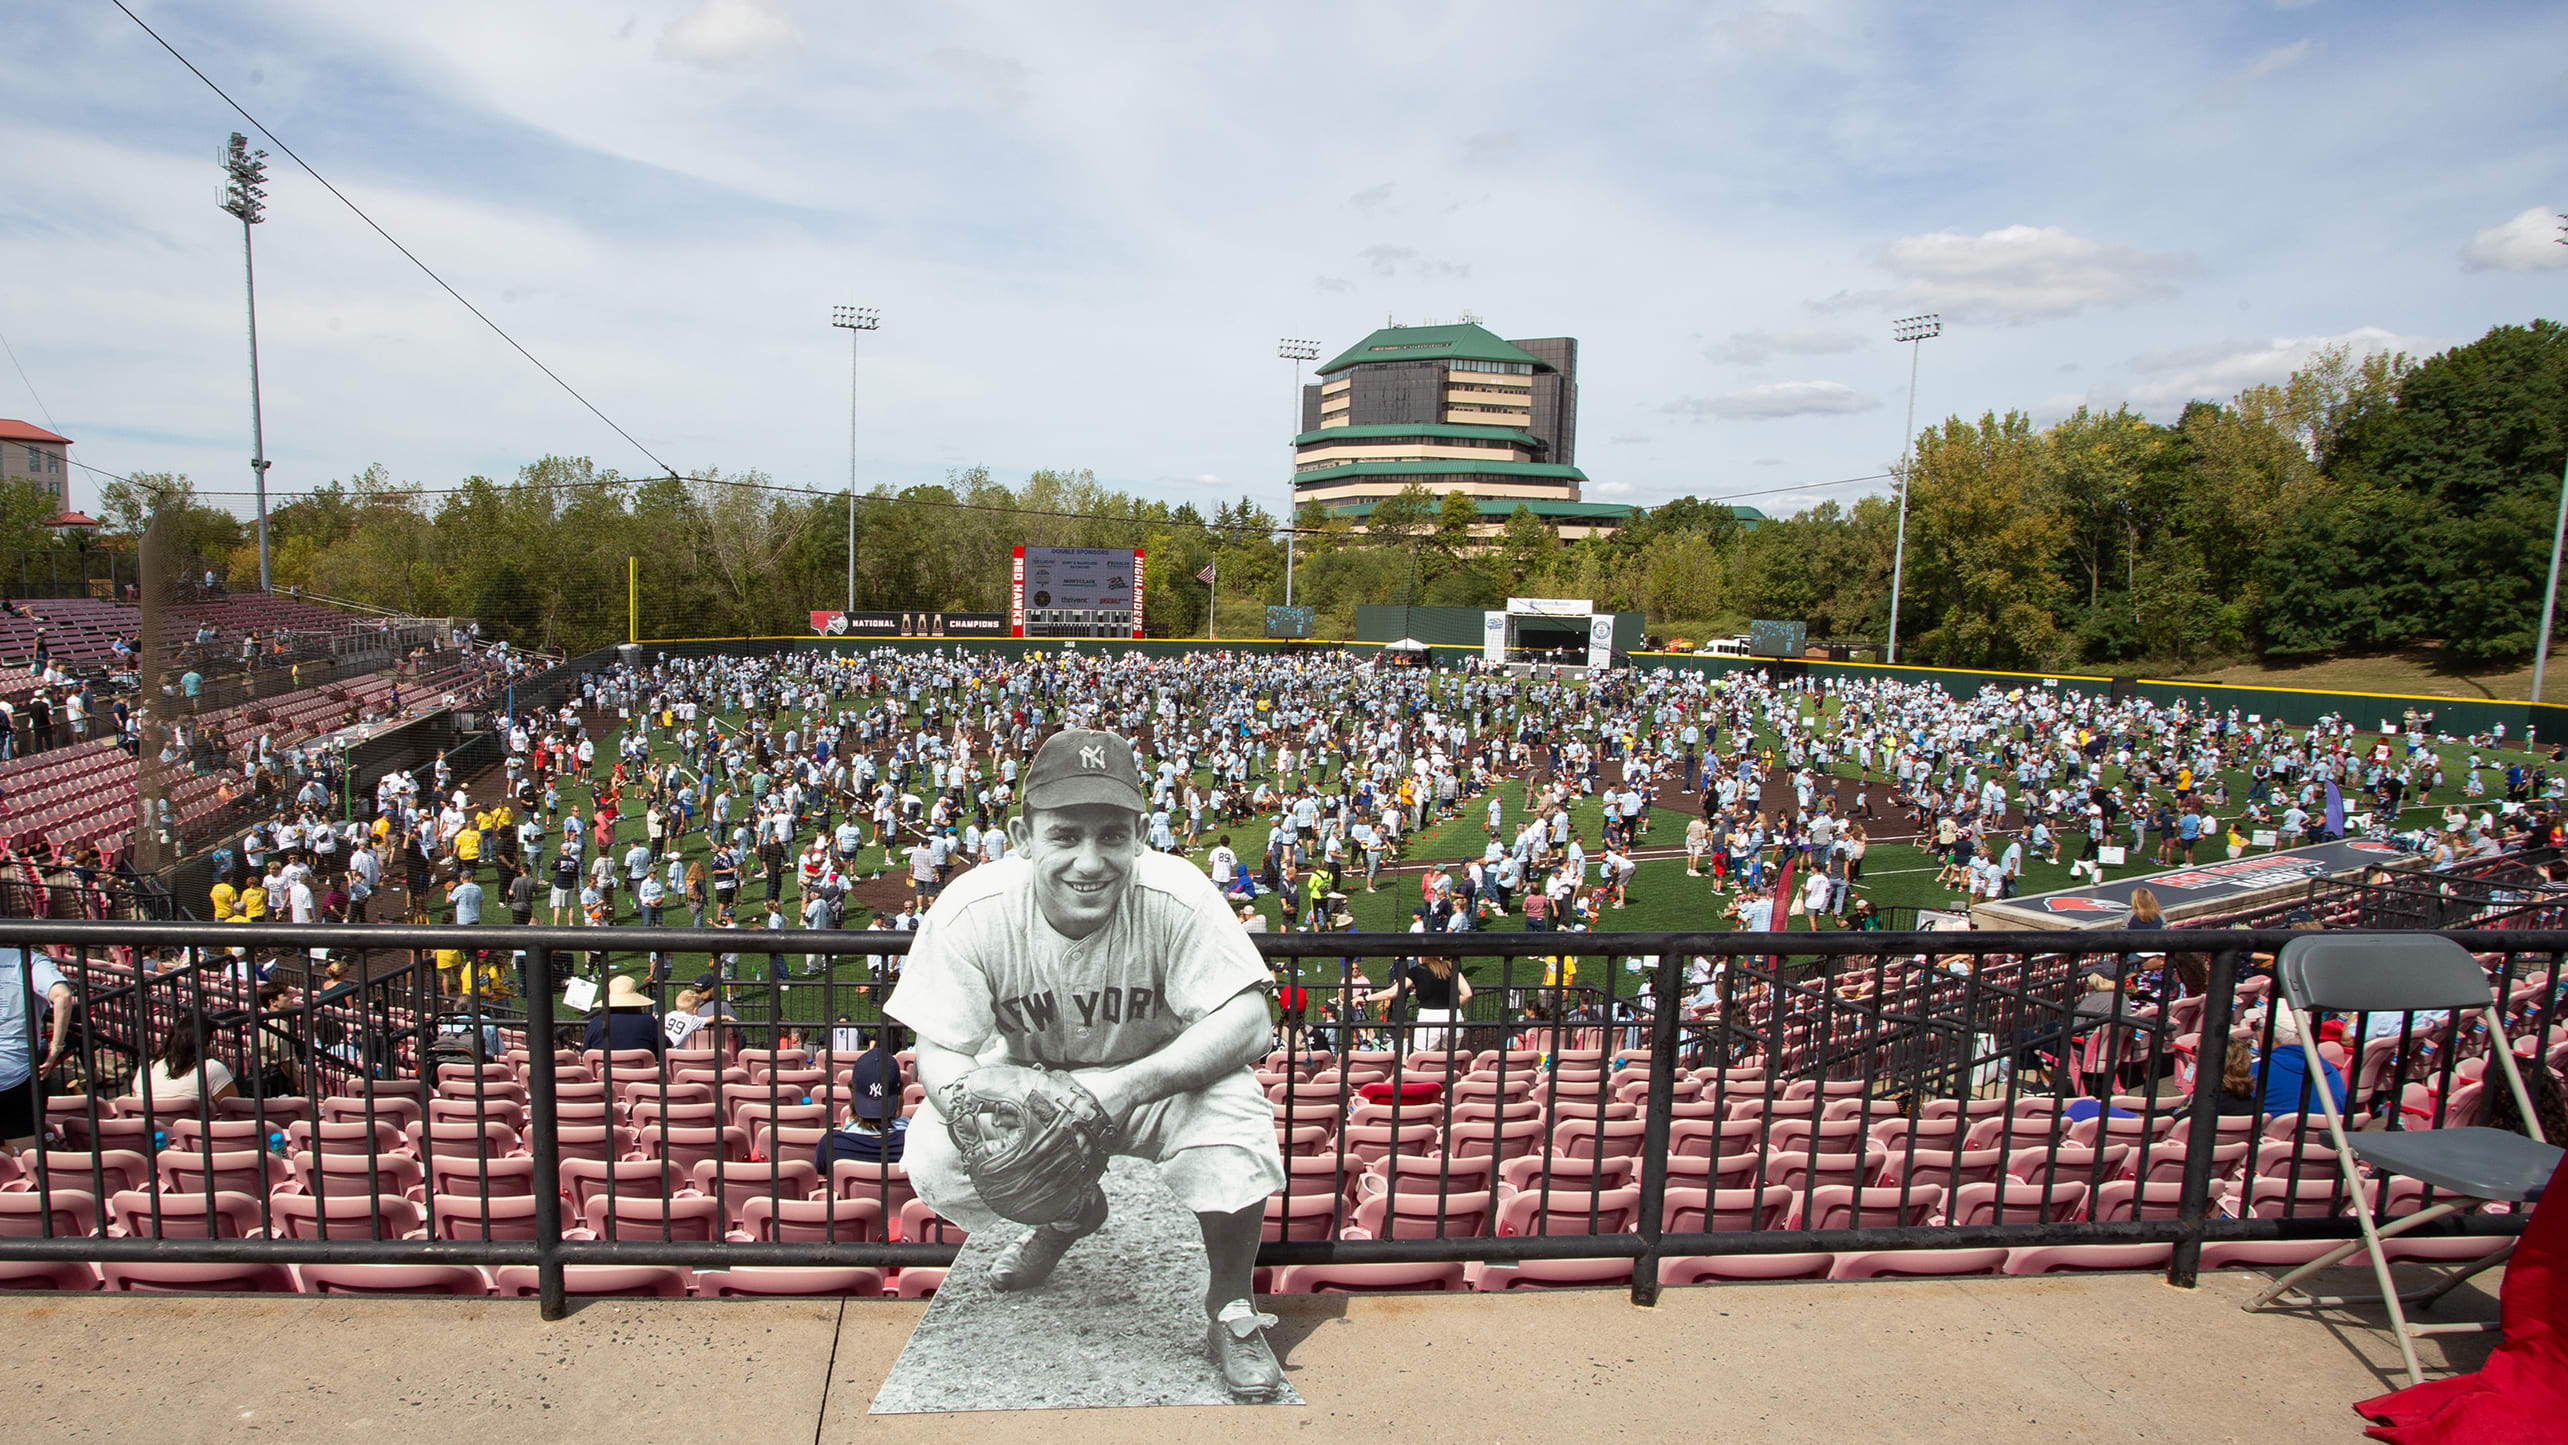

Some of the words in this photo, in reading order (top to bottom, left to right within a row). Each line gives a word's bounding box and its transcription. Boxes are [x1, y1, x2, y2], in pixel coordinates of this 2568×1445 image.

[1013, 557, 1024, 581] RED
[1133, 556, 1144, 631] HIGHLANDERS
[1013, 584, 1023, 626] HAWKS
[852, 619, 896, 627] NATIONAL
[949, 620, 1000, 629] CHAMPIONS
[1218, 852, 1231, 863] 89
[665, 1018, 686, 1035] 99
[869, 1082, 882, 1097] NY
